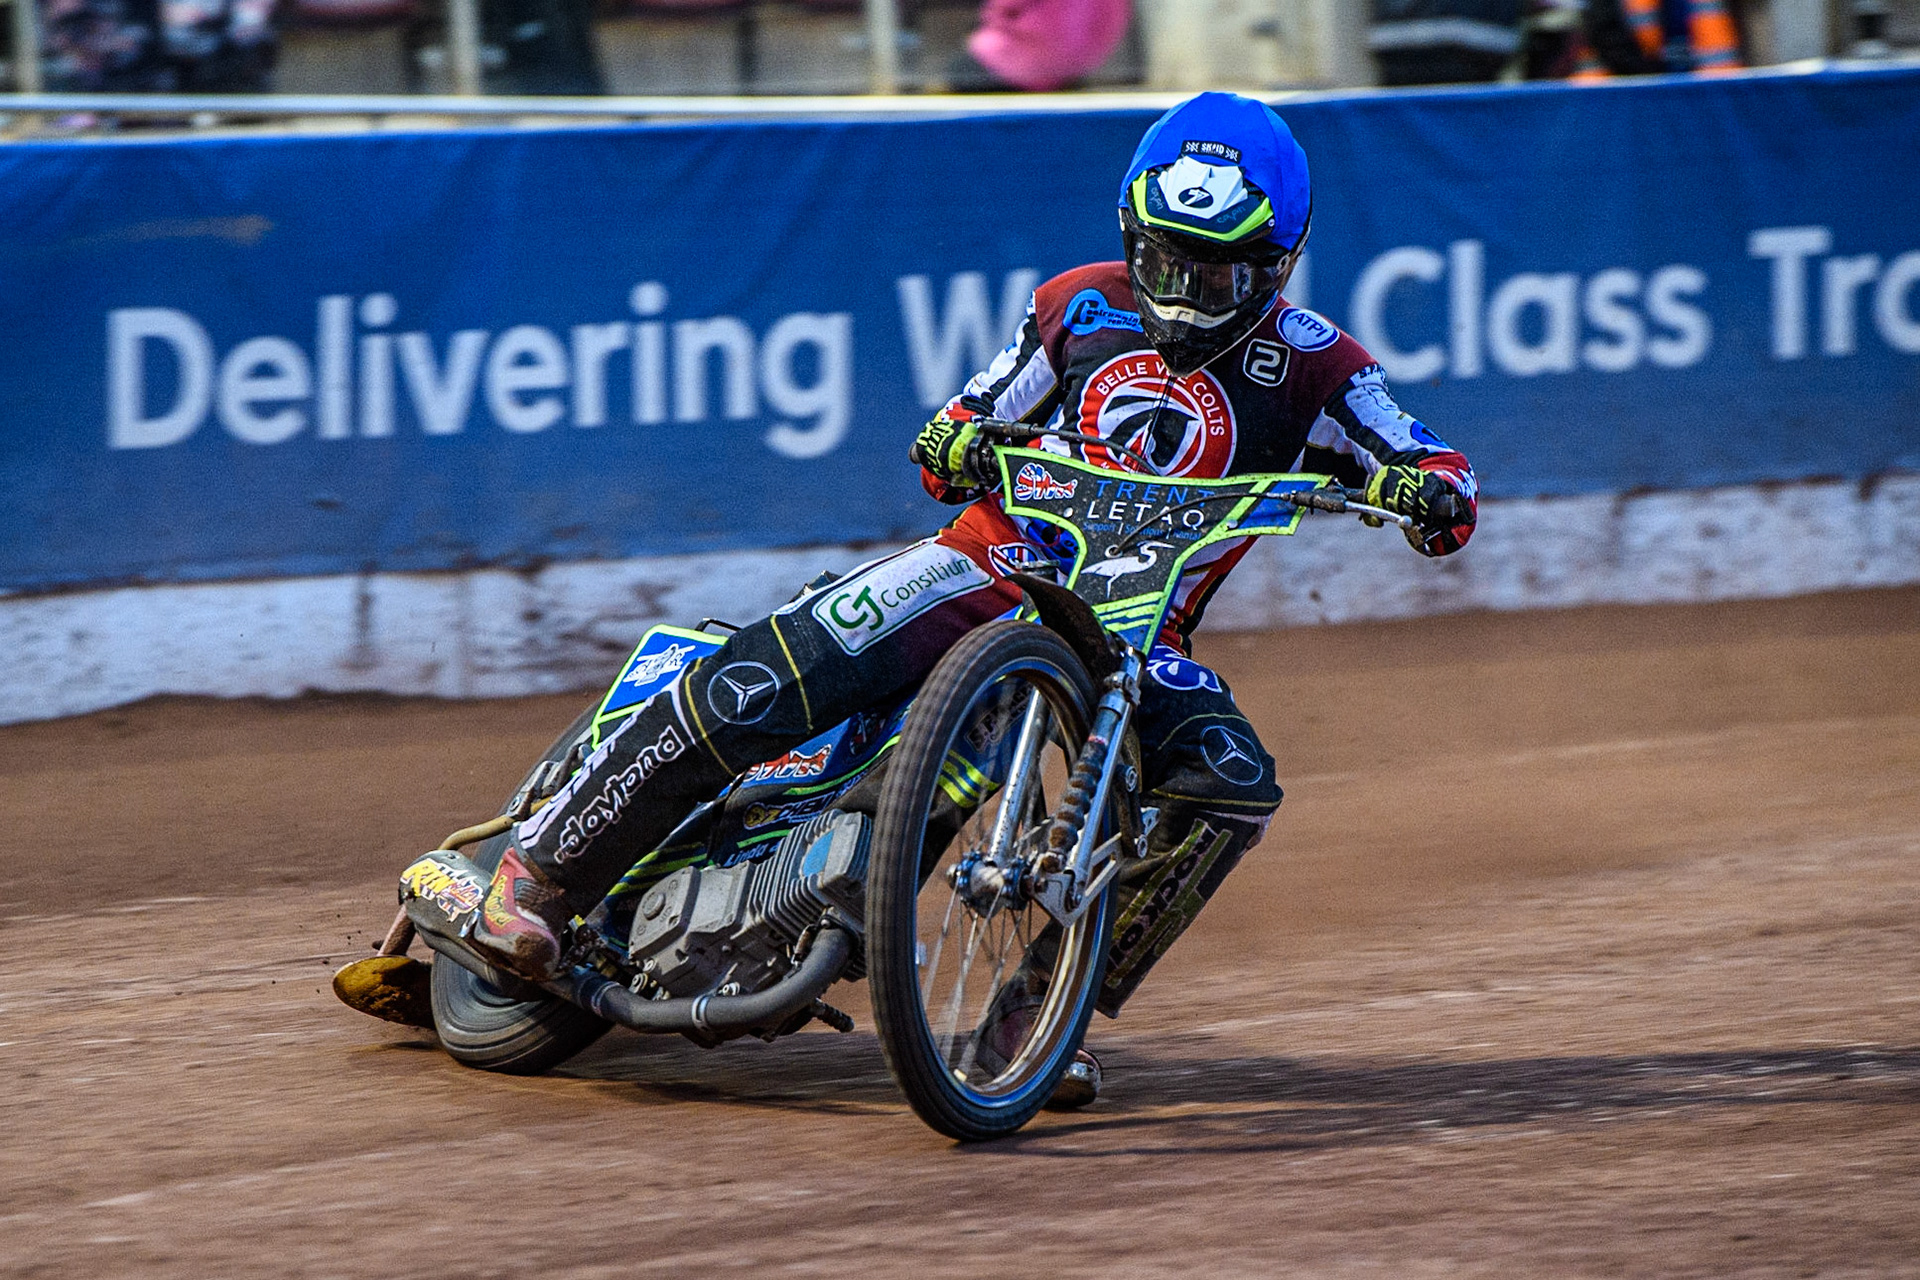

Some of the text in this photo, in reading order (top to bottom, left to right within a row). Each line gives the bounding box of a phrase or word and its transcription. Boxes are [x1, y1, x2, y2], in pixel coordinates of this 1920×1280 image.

[1289, 313, 1328, 338] ATPI
[107, 280, 853, 459] Delivering
[1351, 239, 1711, 383] Class
[1250, 346, 1281, 380] 2
[1096, 362, 1148, 396] BELLE
[1192, 382, 1225, 437] COLTS
[1096, 480, 1215, 508] TRENT
